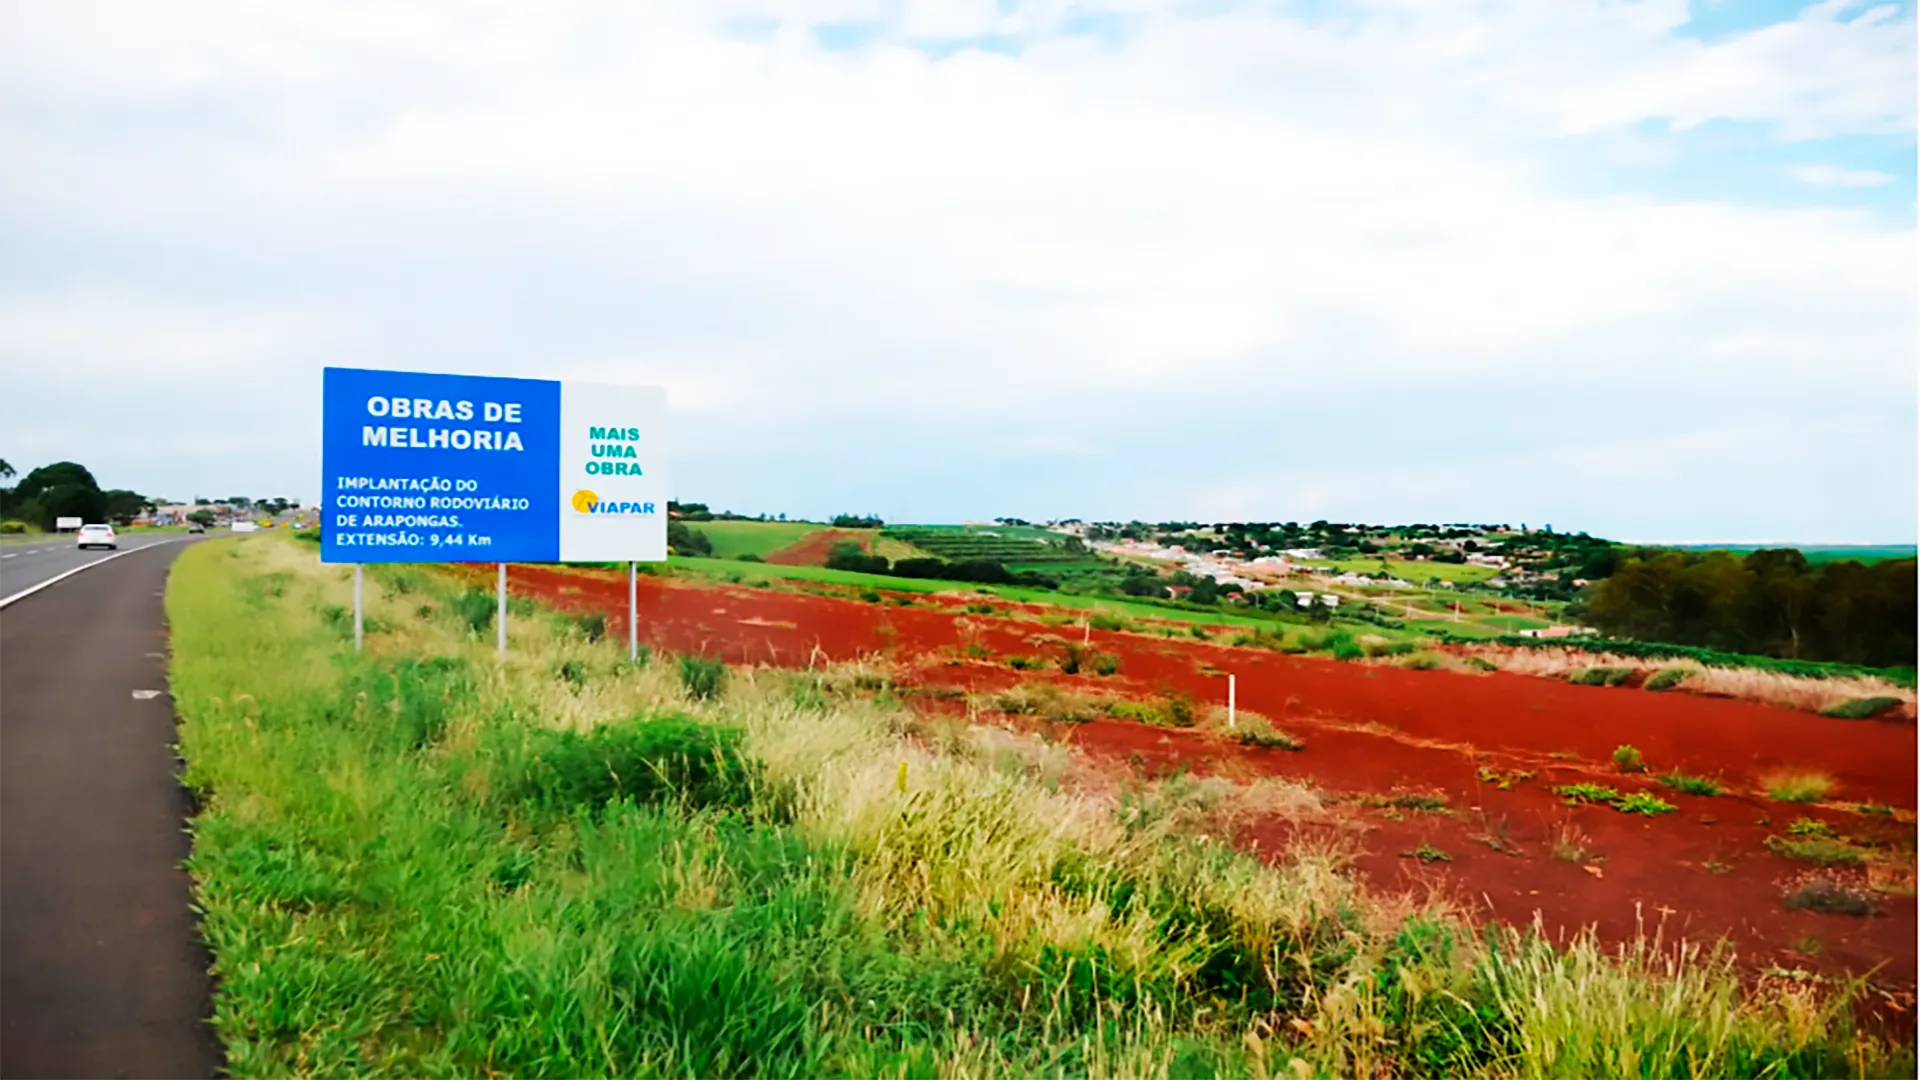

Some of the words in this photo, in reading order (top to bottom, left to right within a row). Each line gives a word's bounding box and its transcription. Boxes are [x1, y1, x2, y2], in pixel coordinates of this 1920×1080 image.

[367, 396, 474, 421] OBRAS
[484, 402, 522, 423] DE
[362, 425, 524, 451] MELHORIA
[589, 426, 640, 441] MAIS
[591, 444, 637, 459] UMA
[585, 461, 642, 476] OBRA
[337, 476, 451, 493] IMPLANTAÇÃO
[456, 479, 478, 492] DO
[336, 495, 426, 509] CONTORNO
[430, 495, 529, 511] RODOVIÁRIO
[587, 501, 655, 514] VIAPAR
[336, 514, 357, 527] DE
[362, 515, 463, 528] ARAPONGAS.
[336, 531, 424, 546] EXTENSÃO:
[430, 534, 463, 548] 9,44
[468, 534, 491, 545] Km
